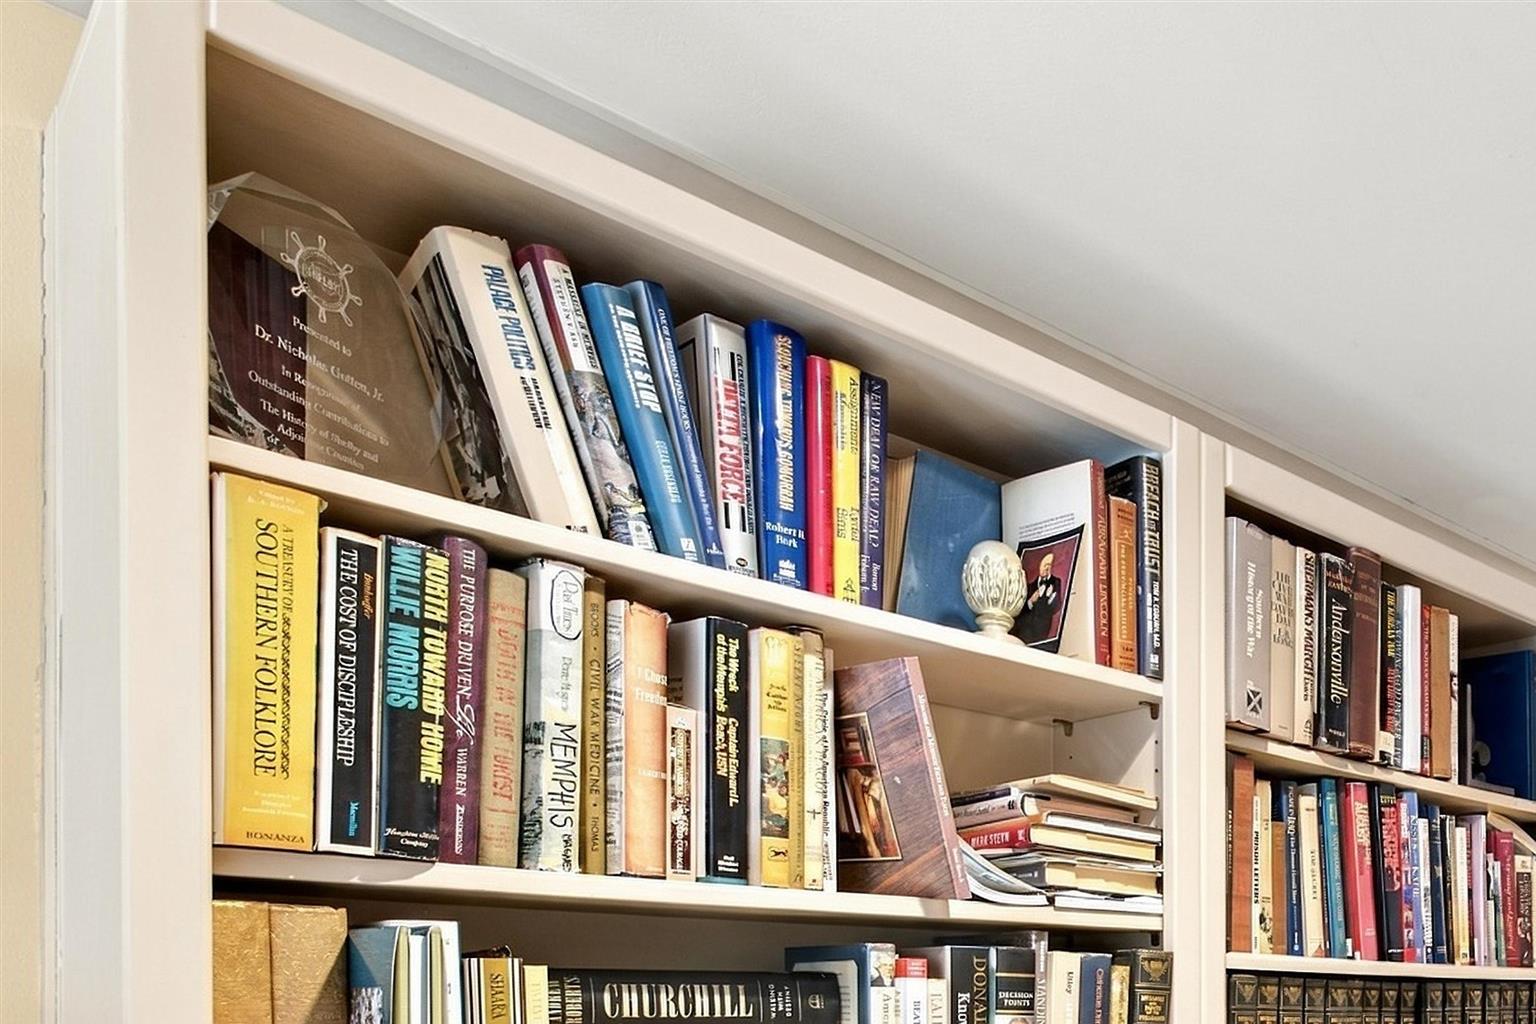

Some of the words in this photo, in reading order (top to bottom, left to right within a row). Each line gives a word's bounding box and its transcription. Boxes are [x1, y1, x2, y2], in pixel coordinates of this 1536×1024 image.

[293, 316, 341, 350] Presented
[481, 264, 517, 317] PALACE
[501, 314, 536, 371] POLITICS
[255, 324, 274, 344] Dr.
[278, 335, 329, 372] Nicholas
[373, 388, 385, 402] Jr.
[248, 370, 311, 408] Outstanding
[261, 398, 281, 416] The
[720, 379, 742, 438] DELTA
[720, 441, 746, 506] FORCE
[777, 450, 795, 512] GOMORRAH
[1143, 462, 1160, 518] BREACH
[340, 546, 358, 579] THE
[462, 548, 476, 571] THE
[1144, 531, 1161, 577] TRUST
[254, 518, 280, 652] SOUTHERN
[339, 581, 358, 629] COST
[388, 545, 421, 620] WILLIE
[423, 551, 450, 625] NORTH
[459, 574, 476, 640] PURPOSE
[1246, 561, 1257, 603] History
[1255, 588, 1265, 640] Southern
[338, 632, 358, 652] OF
[385, 622, 420, 712] MORRIS
[1246, 637, 1257, 659] War
[1329, 596, 1350, 707] Andersonville
[421, 626, 448, 718] TOWARD
[457, 642, 475, 697] DRIVEN
[591, 658, 602, 695] CIVIL
[715, 664, 728, 713] Memphis
[728, 658, 739, 694] Wreck
[253, 655, 279, 780] FOLKLORE
[336, 655, 357, 768] DISCIPLESHIP
[591, 698, 601, 722] WAR
[419, 721, 446, 786] HOME
[455, 747, 468, 797] WARREN
[549, 721, 578, 829] MEMPHIS
[590, 725, 601, 795] MEDICINE
[244, 830, 306, 848] BONANZA
[490, 973, 507, 1020] SHAARA
[563, 976, 583, 1024] ROBERTS
[603, 981, 753, 1019] CHURCHILL
[998, 991, 1034, 999] DECISION
[1065, 970, 1075, 995] Utley
